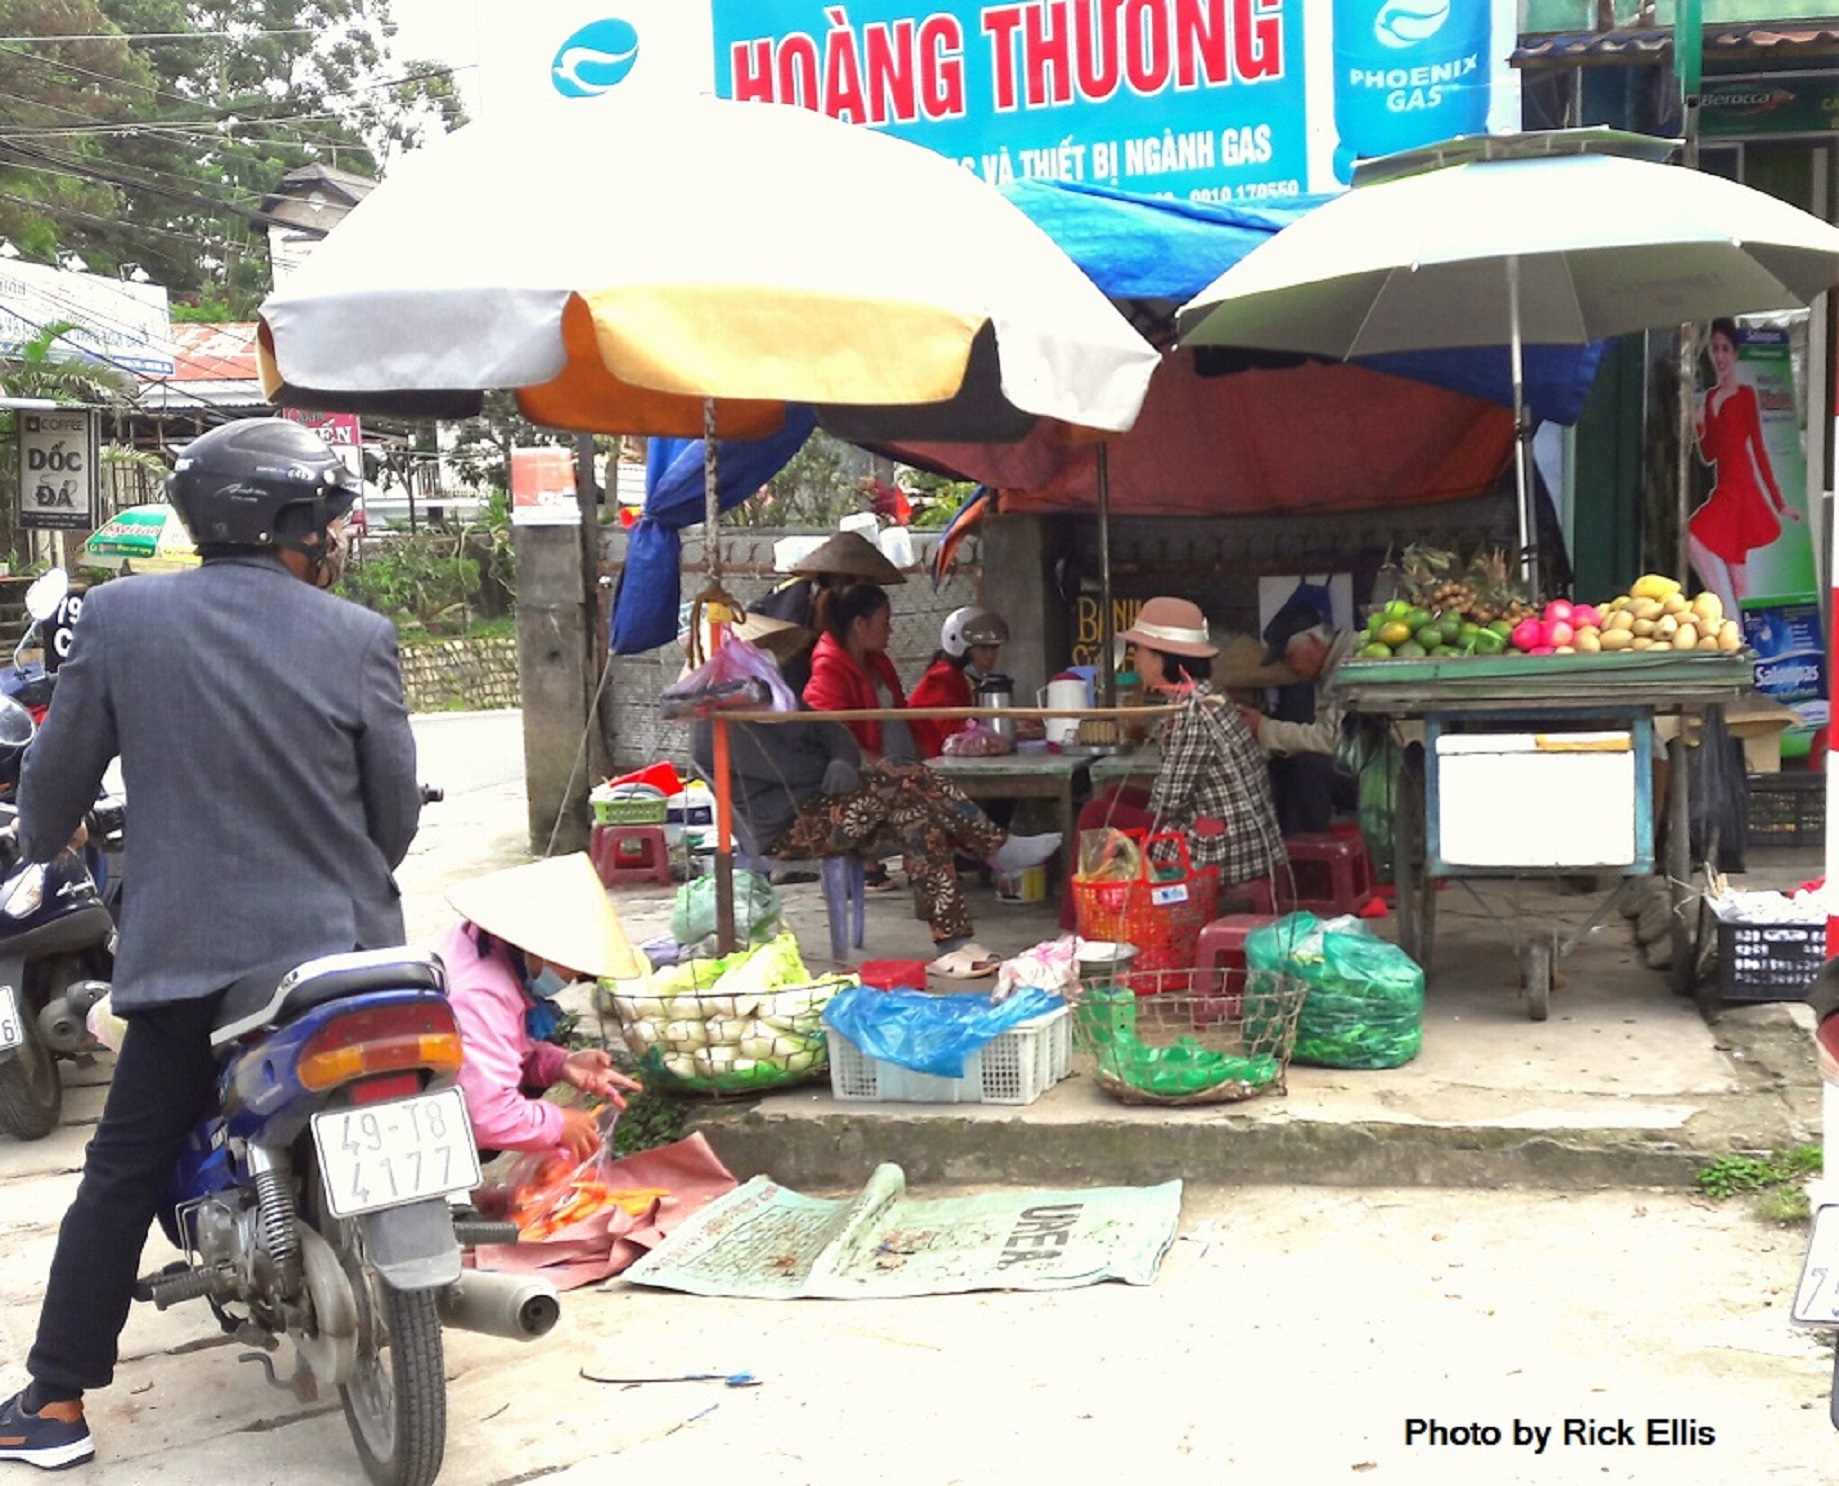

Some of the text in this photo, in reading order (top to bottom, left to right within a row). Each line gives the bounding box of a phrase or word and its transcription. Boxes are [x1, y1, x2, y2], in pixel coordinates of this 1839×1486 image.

[731, 5, 966, 126] HOÀNG
[1350, 53, 1477, 88] PHOENIX
[1387, 85, 1442, 112] GAS
[1700, 93, 1771, 107] Berocca
[981, 146, 1014, 185] VÀ
[1019, 134, 1086, 181] THIẾT
[1093, 140, 1118, 186] BỊ
[1125, 127, 1214, 177] NGÀNH
[1221, 123, 1272, 168] GAS
[1755, 664, 1820, 688] Salonpas
[351, 1145, 451, 1204] 4177
